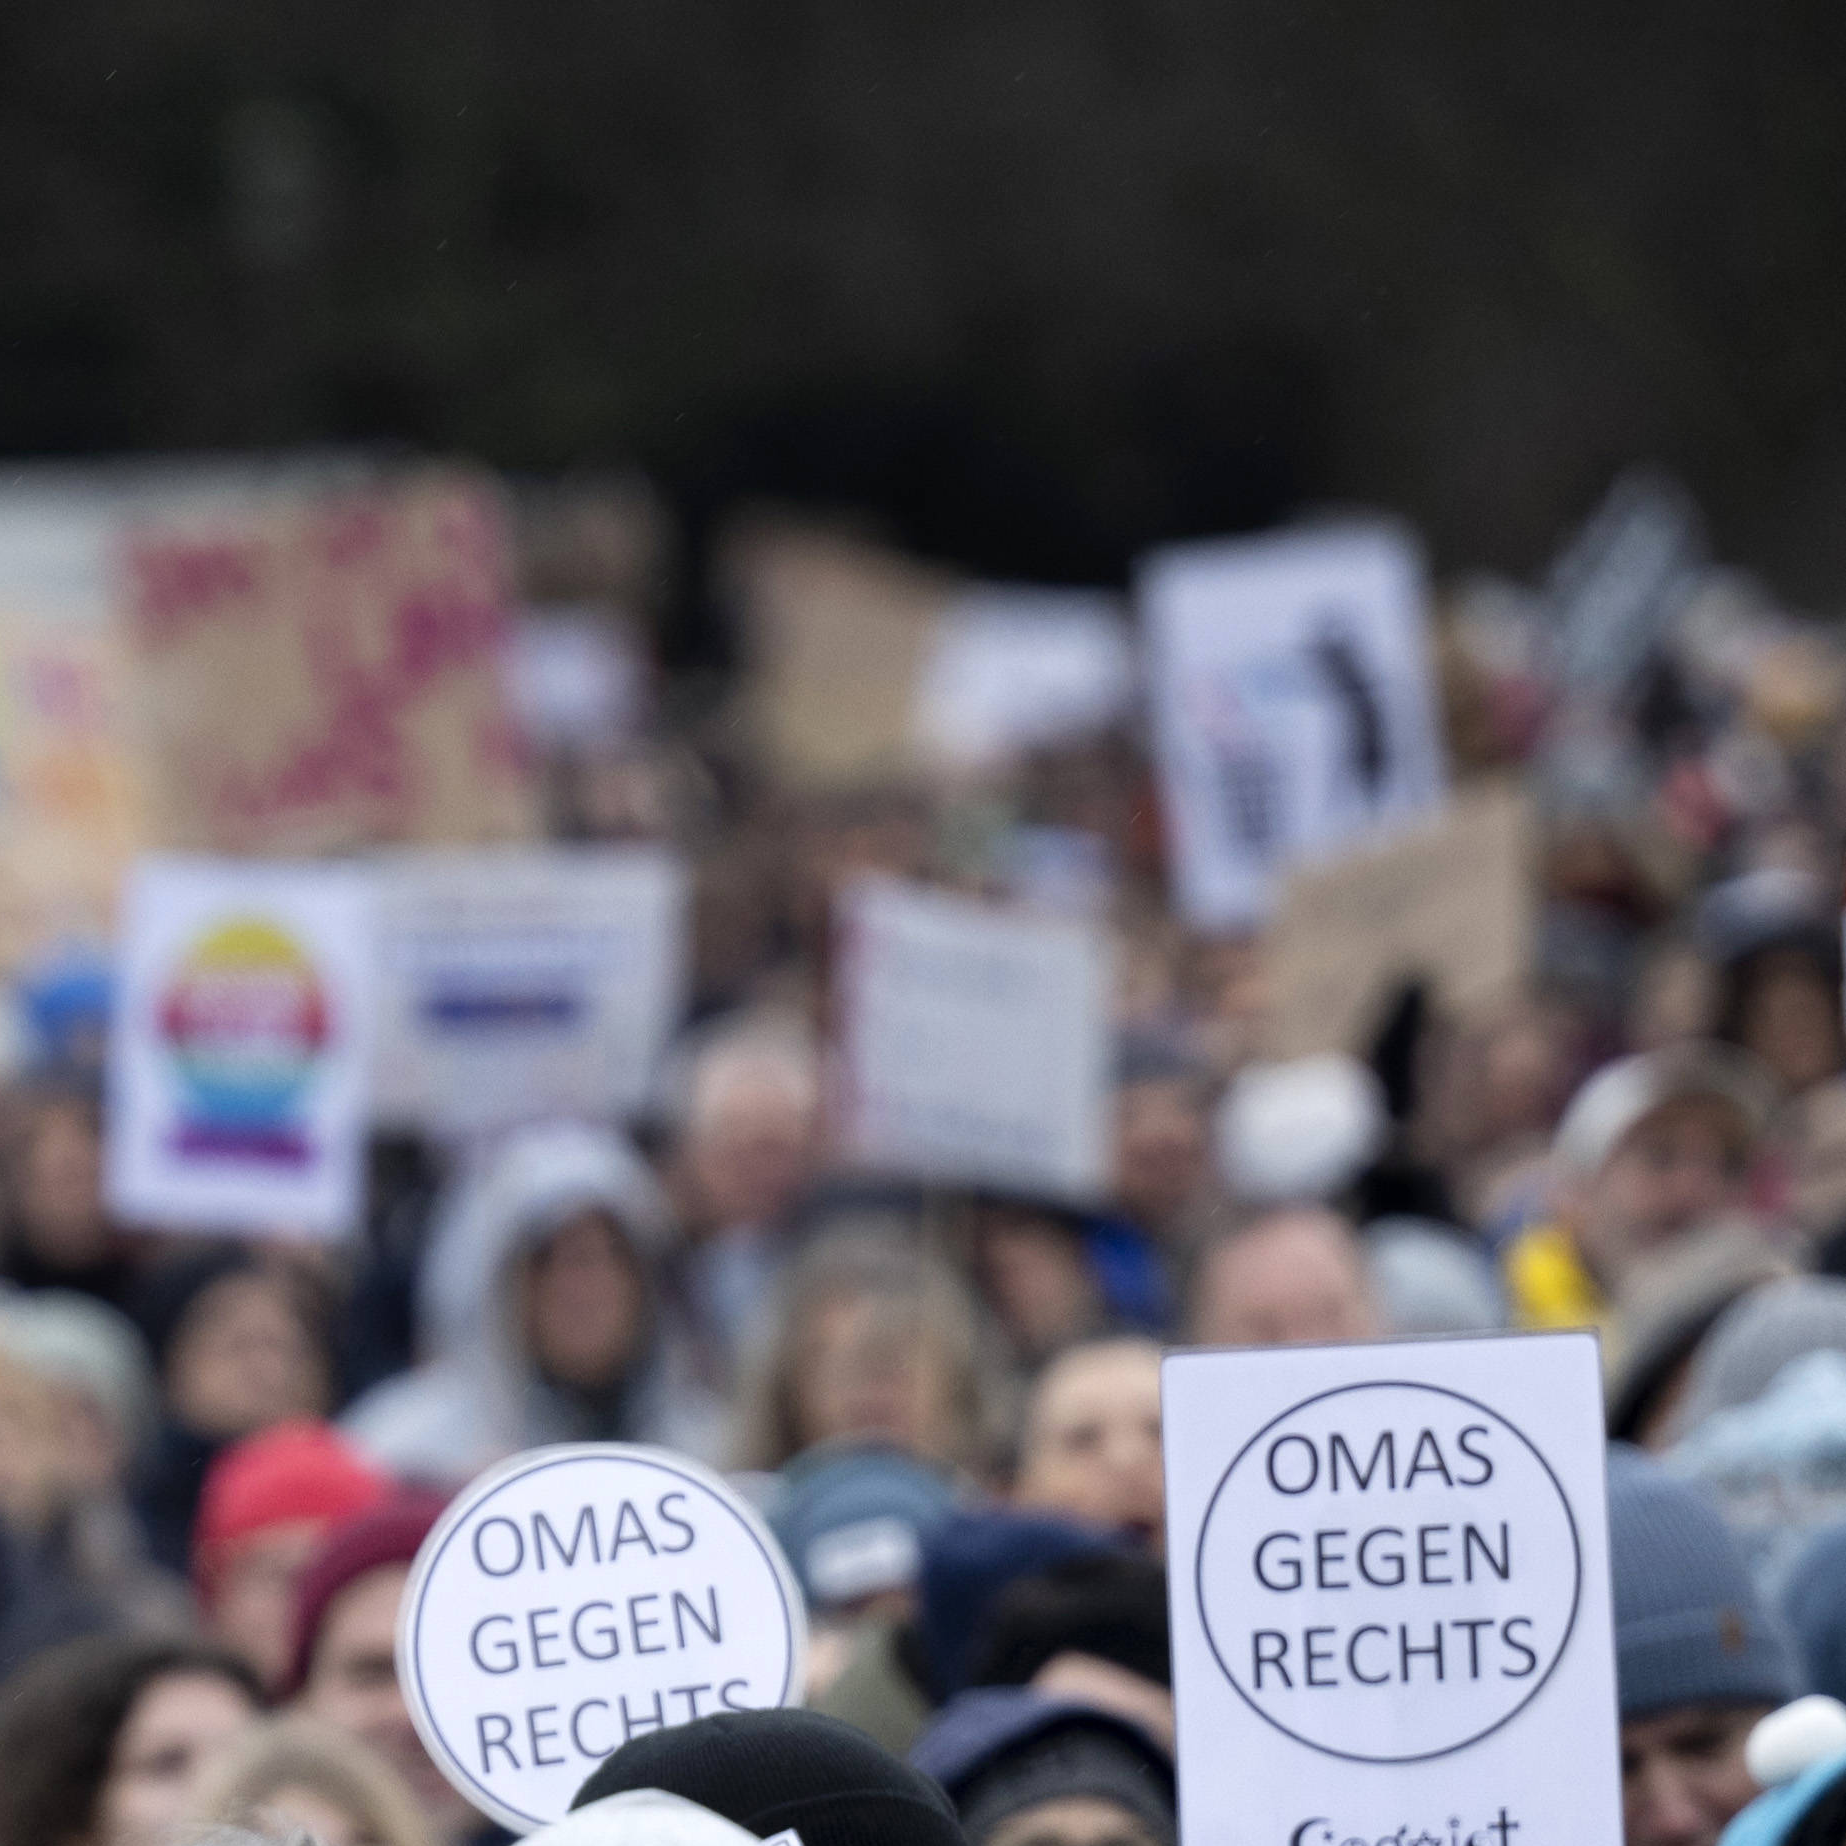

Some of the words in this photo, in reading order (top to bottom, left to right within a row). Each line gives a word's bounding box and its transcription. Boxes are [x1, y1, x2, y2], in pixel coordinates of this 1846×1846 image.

[1265, 1425, 1495, 1495] OMAS
[473, 1492, 696, 1577] OMAS
[1252, 1521, 1511, 1591] GEGEN
[470, 1586, 723, 1674] GEGEN
[1252, 1617, 1537, 1690] RECHTS
